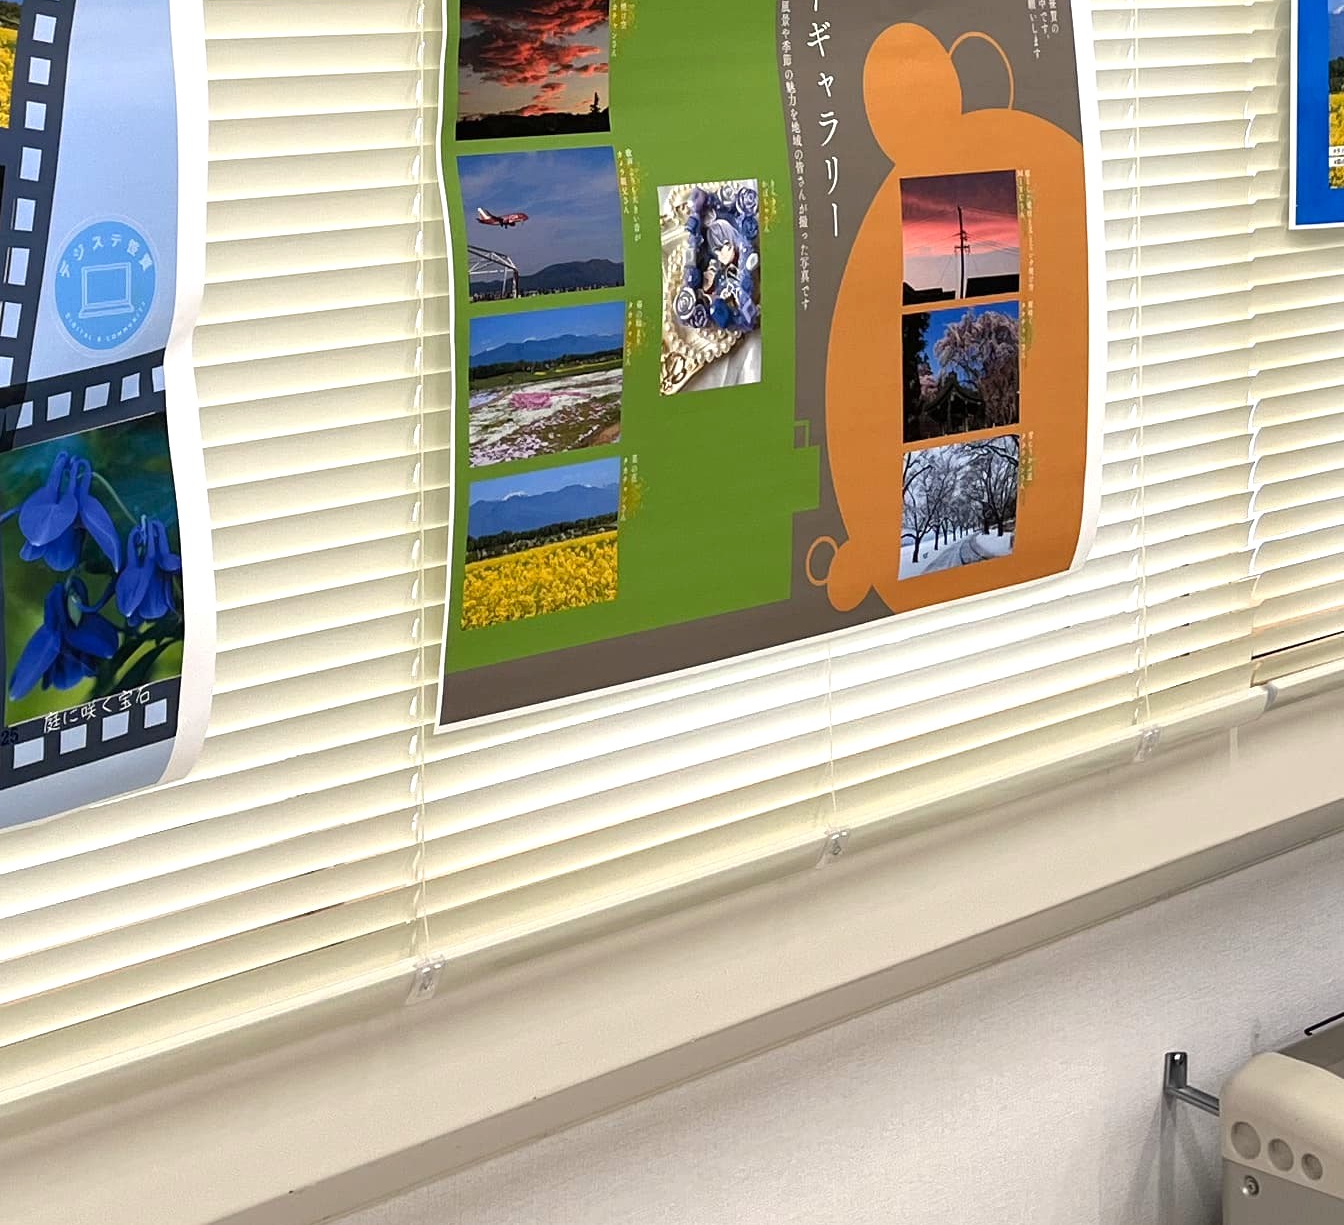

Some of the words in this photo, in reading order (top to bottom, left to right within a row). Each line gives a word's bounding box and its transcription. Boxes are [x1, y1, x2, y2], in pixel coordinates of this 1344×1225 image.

[41, 684, 153, 734] 庭に咲く宝石
